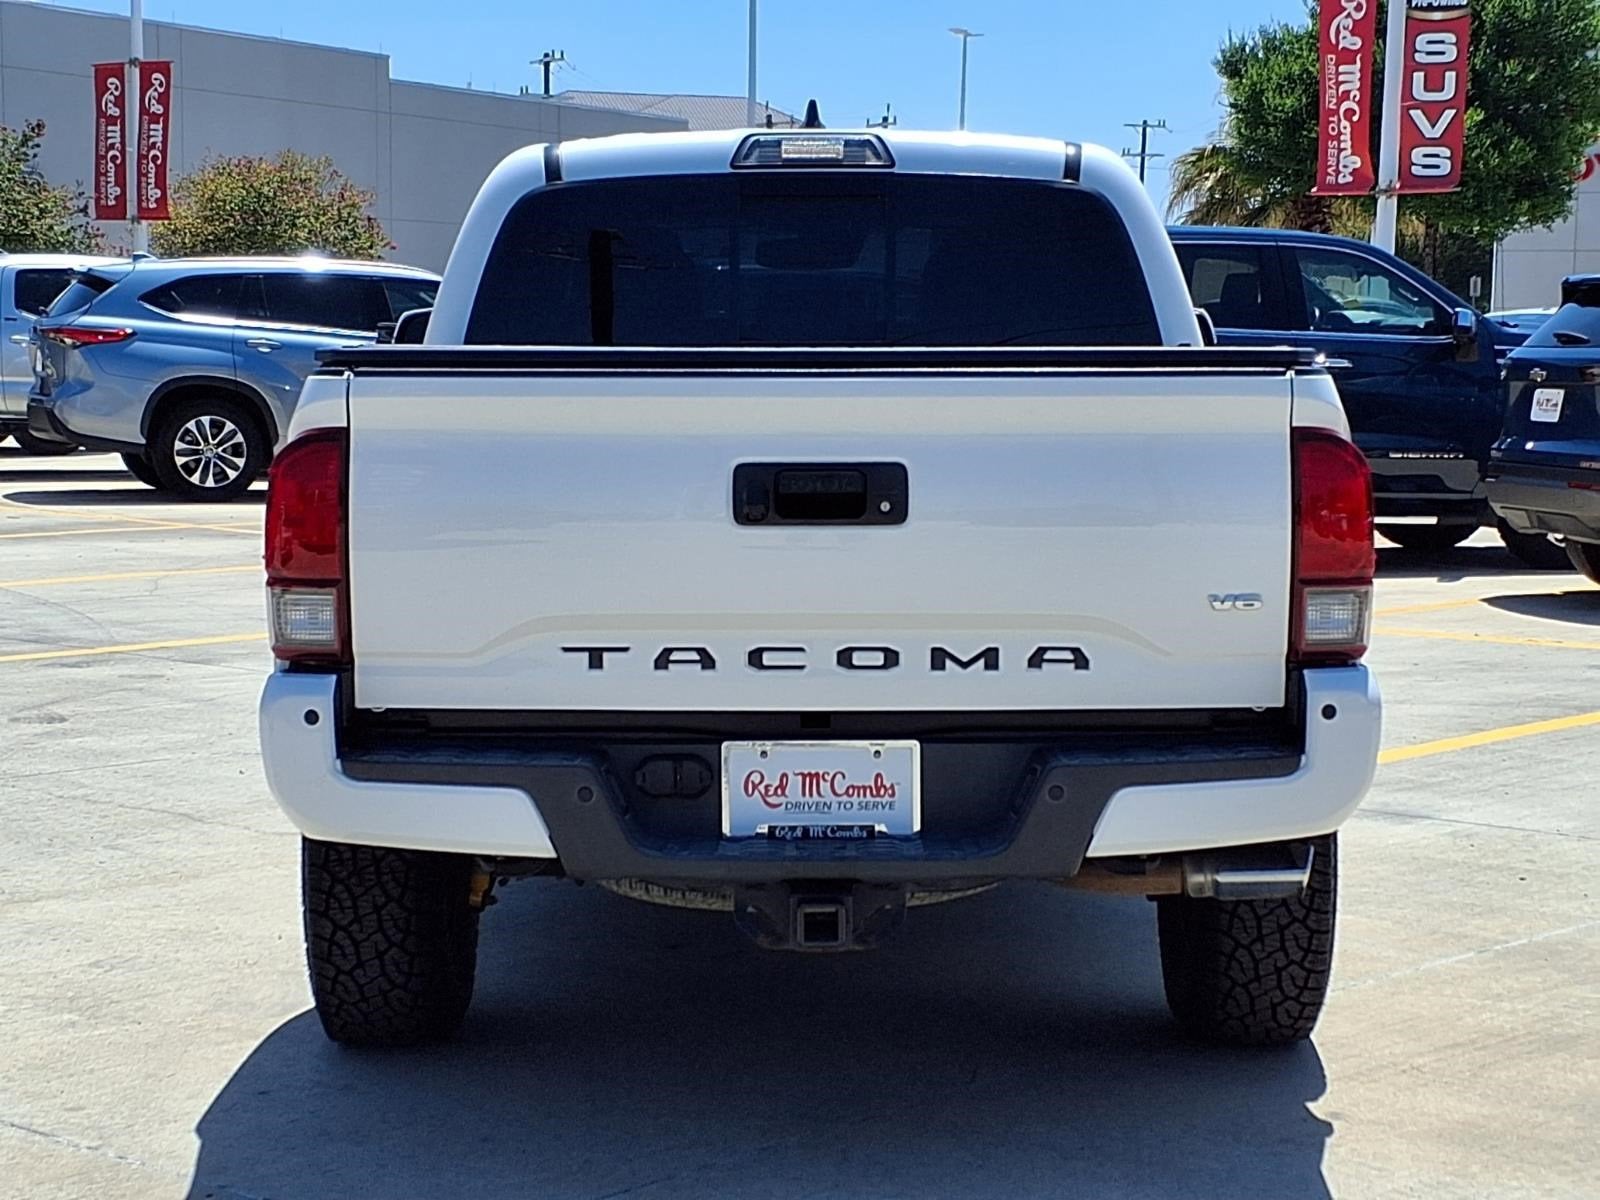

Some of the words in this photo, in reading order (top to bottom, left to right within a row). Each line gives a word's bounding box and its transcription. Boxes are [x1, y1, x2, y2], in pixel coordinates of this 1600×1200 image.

[1330, 0, 1367, 50] Red
[102, 77, 121, 117] Red
[145, 72, 166, 114] Red
[1326, 55, 1336, 110] DRIVEN
[1328, 115, 1338, 135] TO
[1337, 53, 1362, 184] McCombs
[1326, 141, 1338, 185] SERVE
[1208, 592, 1263, 611] V6
[561, 646, 1091, 671] TACOMA
[743, 770, 788, 809] Red
[793, 770, 897, 799] McCombs
[784, 801, 833, 813] DRIVEN
[837, 801, 854, 811] TO
[857, 800, 896, 812] SERVE
[775, 825, 803, 840] Red
